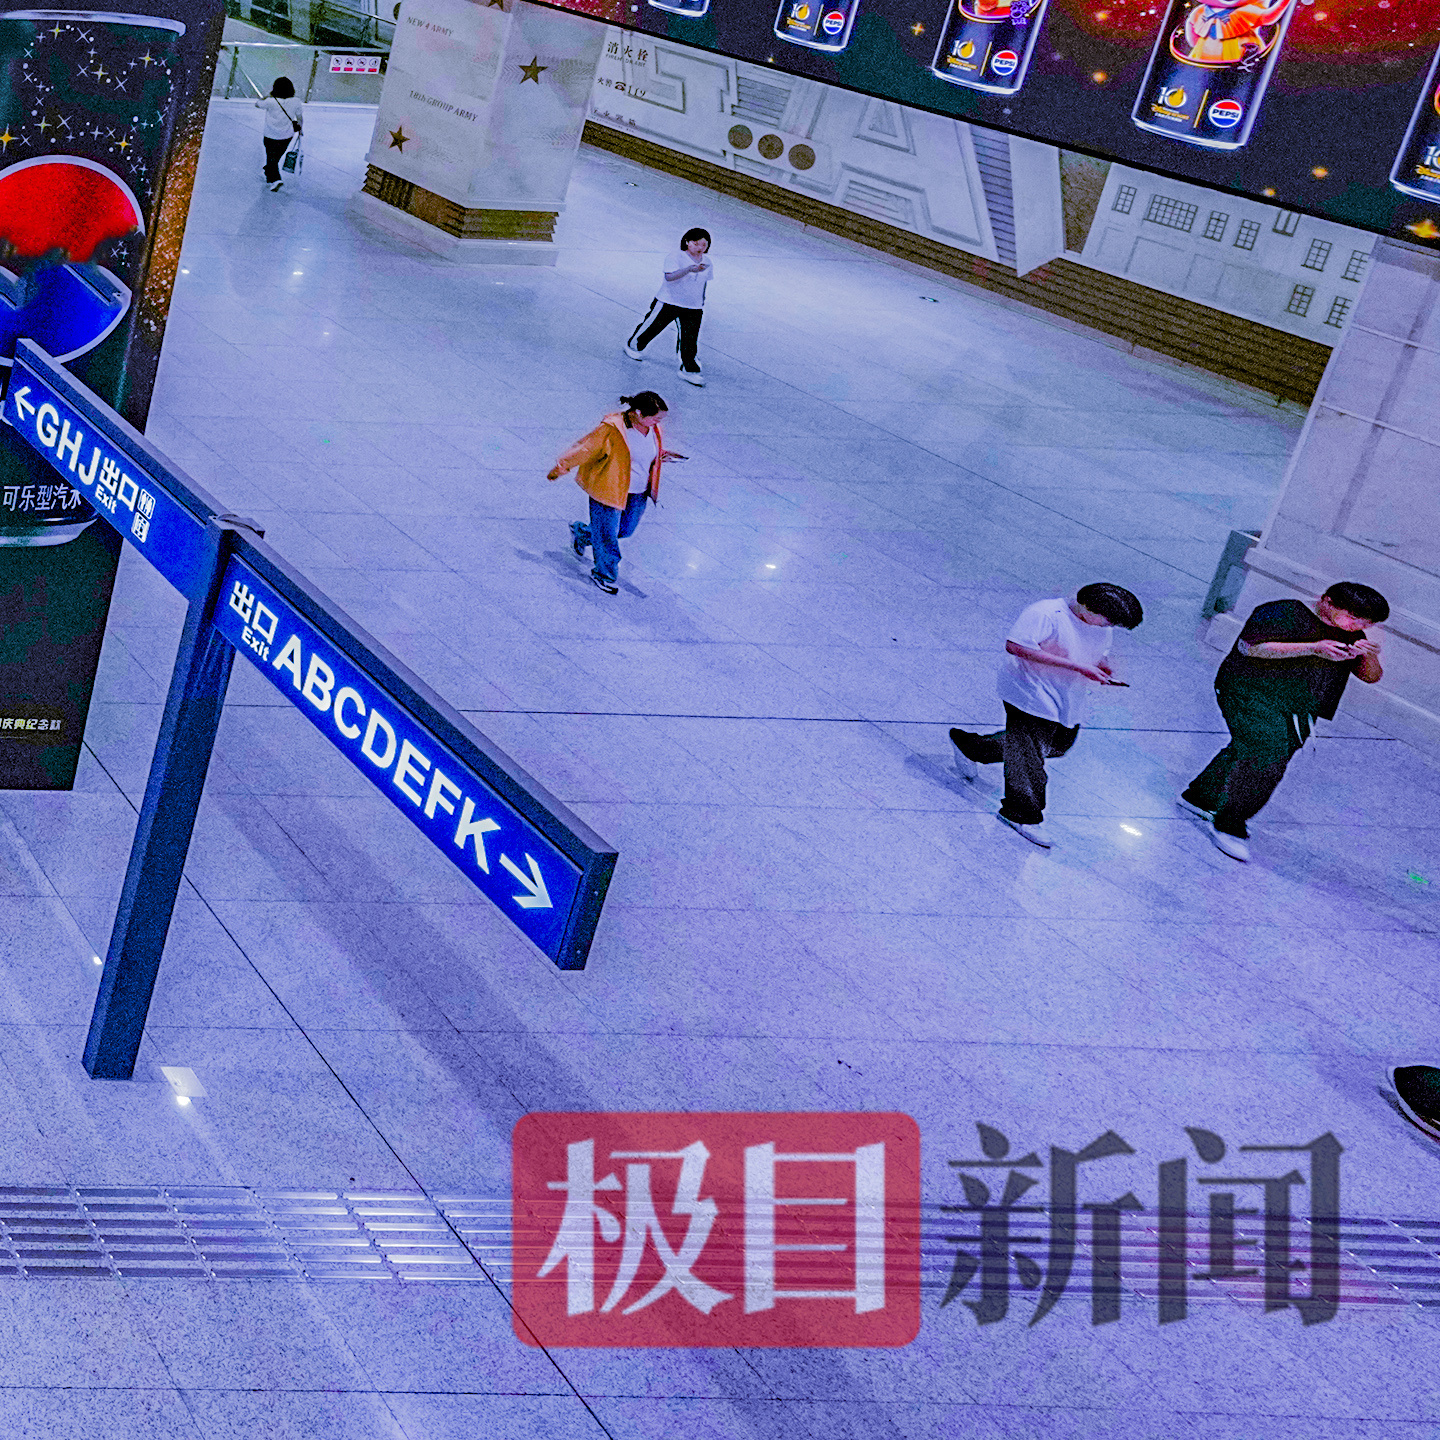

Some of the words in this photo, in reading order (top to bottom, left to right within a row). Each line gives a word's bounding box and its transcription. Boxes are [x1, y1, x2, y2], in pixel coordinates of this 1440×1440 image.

[406, 17, 424, 28] NEW
[431, 24, 454, 37] ARMY
[607, 41, 649, 61] 消火栓
[426, 96, 454, 112] GROUP
[453, 107, 478, 121] ARMY
[1157, 86, 1188, 109] 10
[36, 402, 102, 486] GHJ
[3, 482, 83, 512] 可乐型汽水
[94, 484, 117, 514] Exit
[98, 456, 139, 512] 出口
[229, 580, 279, 646] 出口
[241, 625, 271, 662] Exit
[272, 634, 502, 875] ABCDEFK
